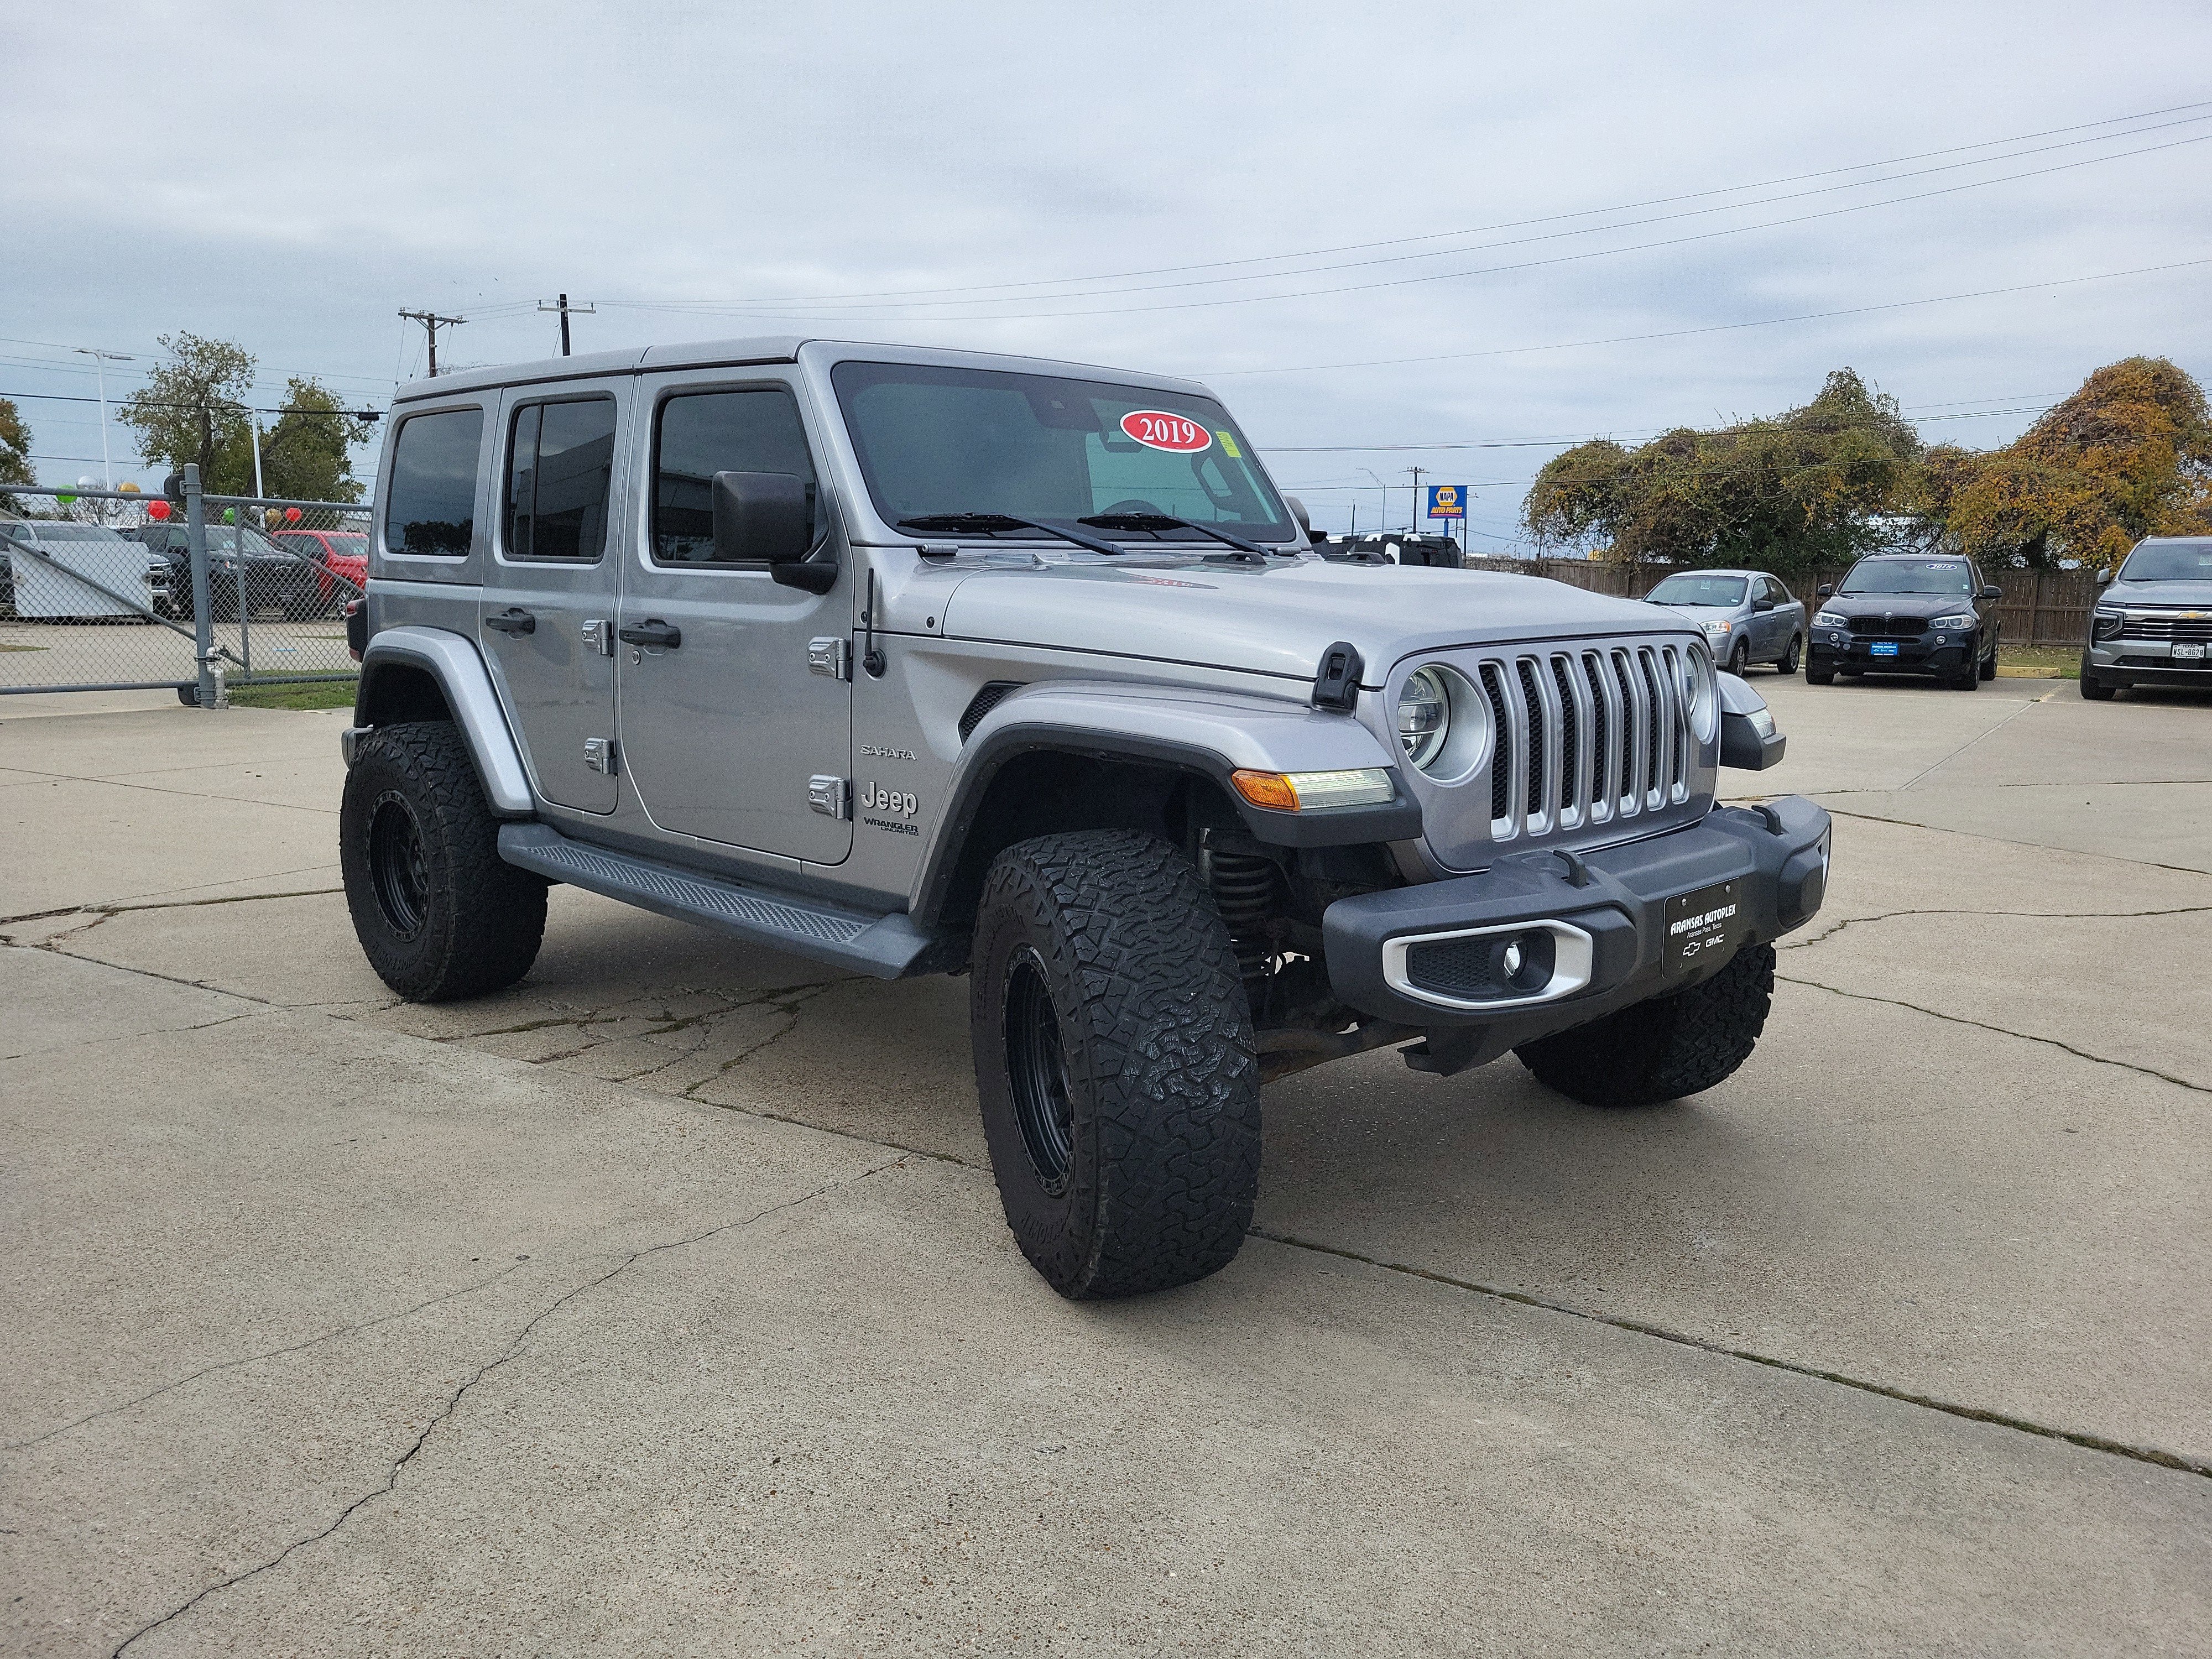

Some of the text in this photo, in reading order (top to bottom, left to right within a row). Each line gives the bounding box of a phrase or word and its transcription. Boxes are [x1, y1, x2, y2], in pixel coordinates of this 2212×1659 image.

[1140, 418, 1196, 444] 2019
[1439, 492, 1454, 501] NAPA
[860, 745, 917, 760] SAHARA
[861, 781, 918, 819] Jeep
[864, 817, 919, 833] WRANGLER
[880, 827, 919, 836] UNLIMITED
[1670, 904, 1736, 936] ARANSAS AUTOPLEX
[1687, 928, 1702, 938] Aransas
[1705, 934, 1724, 948] GMC
